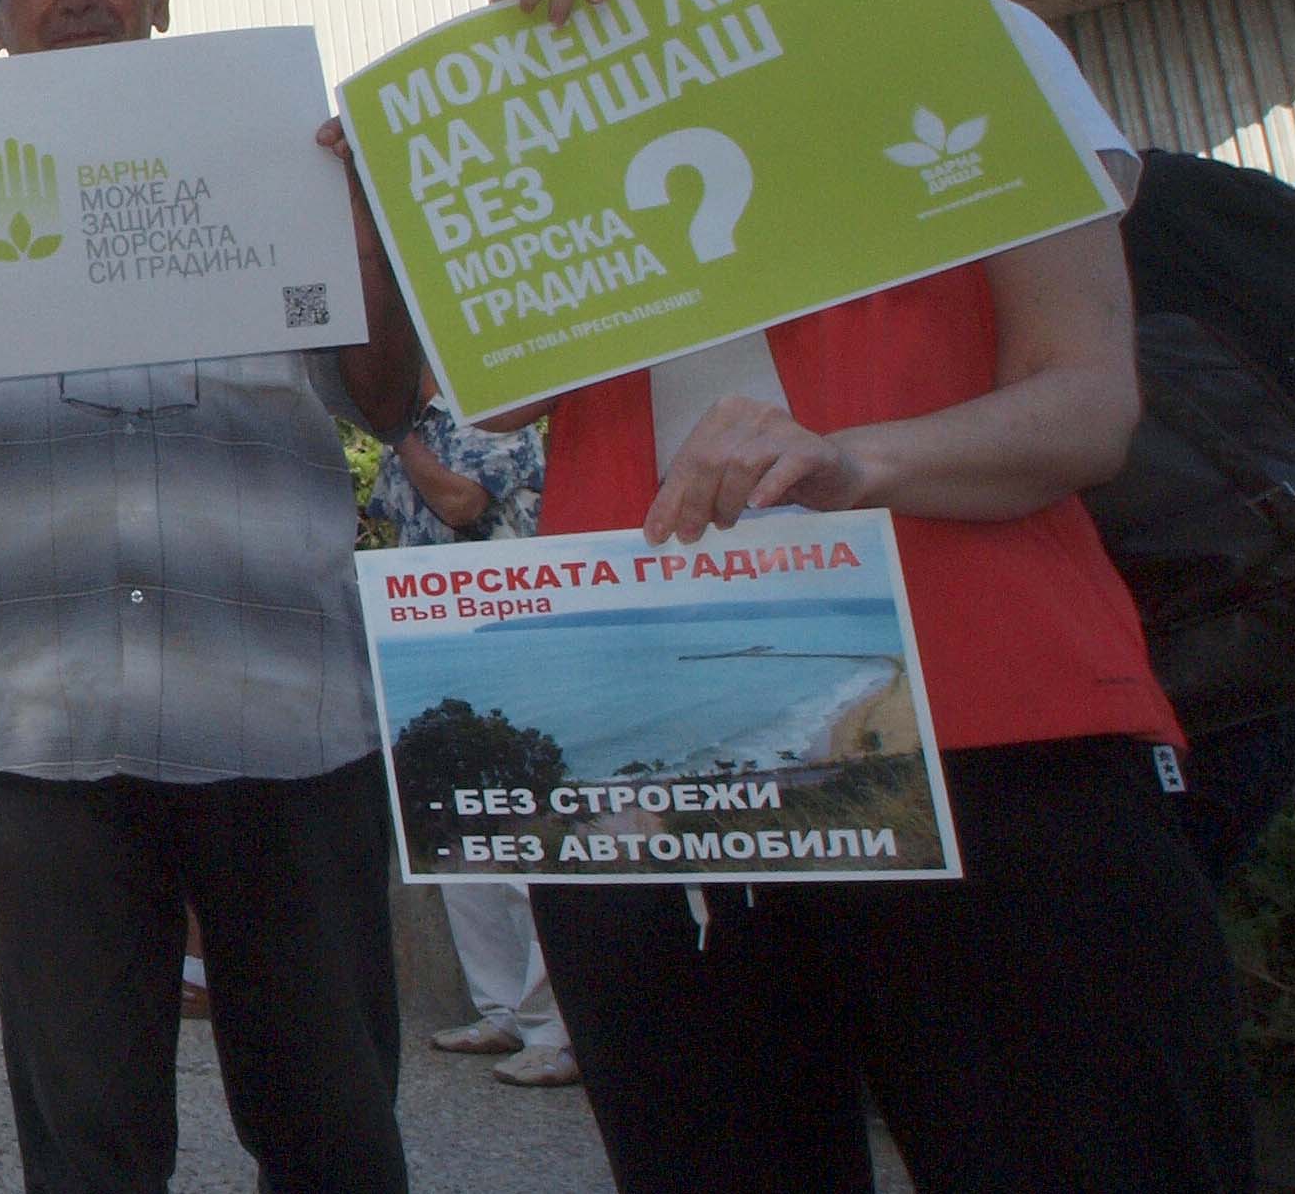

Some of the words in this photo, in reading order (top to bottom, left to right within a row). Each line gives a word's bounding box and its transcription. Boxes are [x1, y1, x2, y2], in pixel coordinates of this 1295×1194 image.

[408, 118, 495, 203] ДА
[502, 4, 784, 165] ДИШАШ
[77, 157, 169, 188] ВАРНА
[80, 181, 166, 212] МОЖЕ
[174, 177, 211, 208] ДА
[421, 166, 554, 255] БЕЗ
[82, 202, 201, 236] ЗАЩИТИ
[86, 224, 237, 261] МОРСКАТА
[444, 208, 635, 295] МОРСКА
[88, 260, 126, 285] СИ
[135, 245, 262, 280] ГРАДИНА
[459, 243, 668, 336] ГРАДИНА
[386, 558, 620, 600] МОРСКАТА
[633, 541, 862, 584] ГРАДИНА
[390, 601, 448, 622] във
[457, 594, 553, 622] Варна
[455, 786, 537, 816] БЕЗ
[549, 780, 782, 815] СТРОЕЖИ
[463, 833, 546, 863] БЕЗ
[558, 828, 898, 862] АВТОМОБИЛИ
